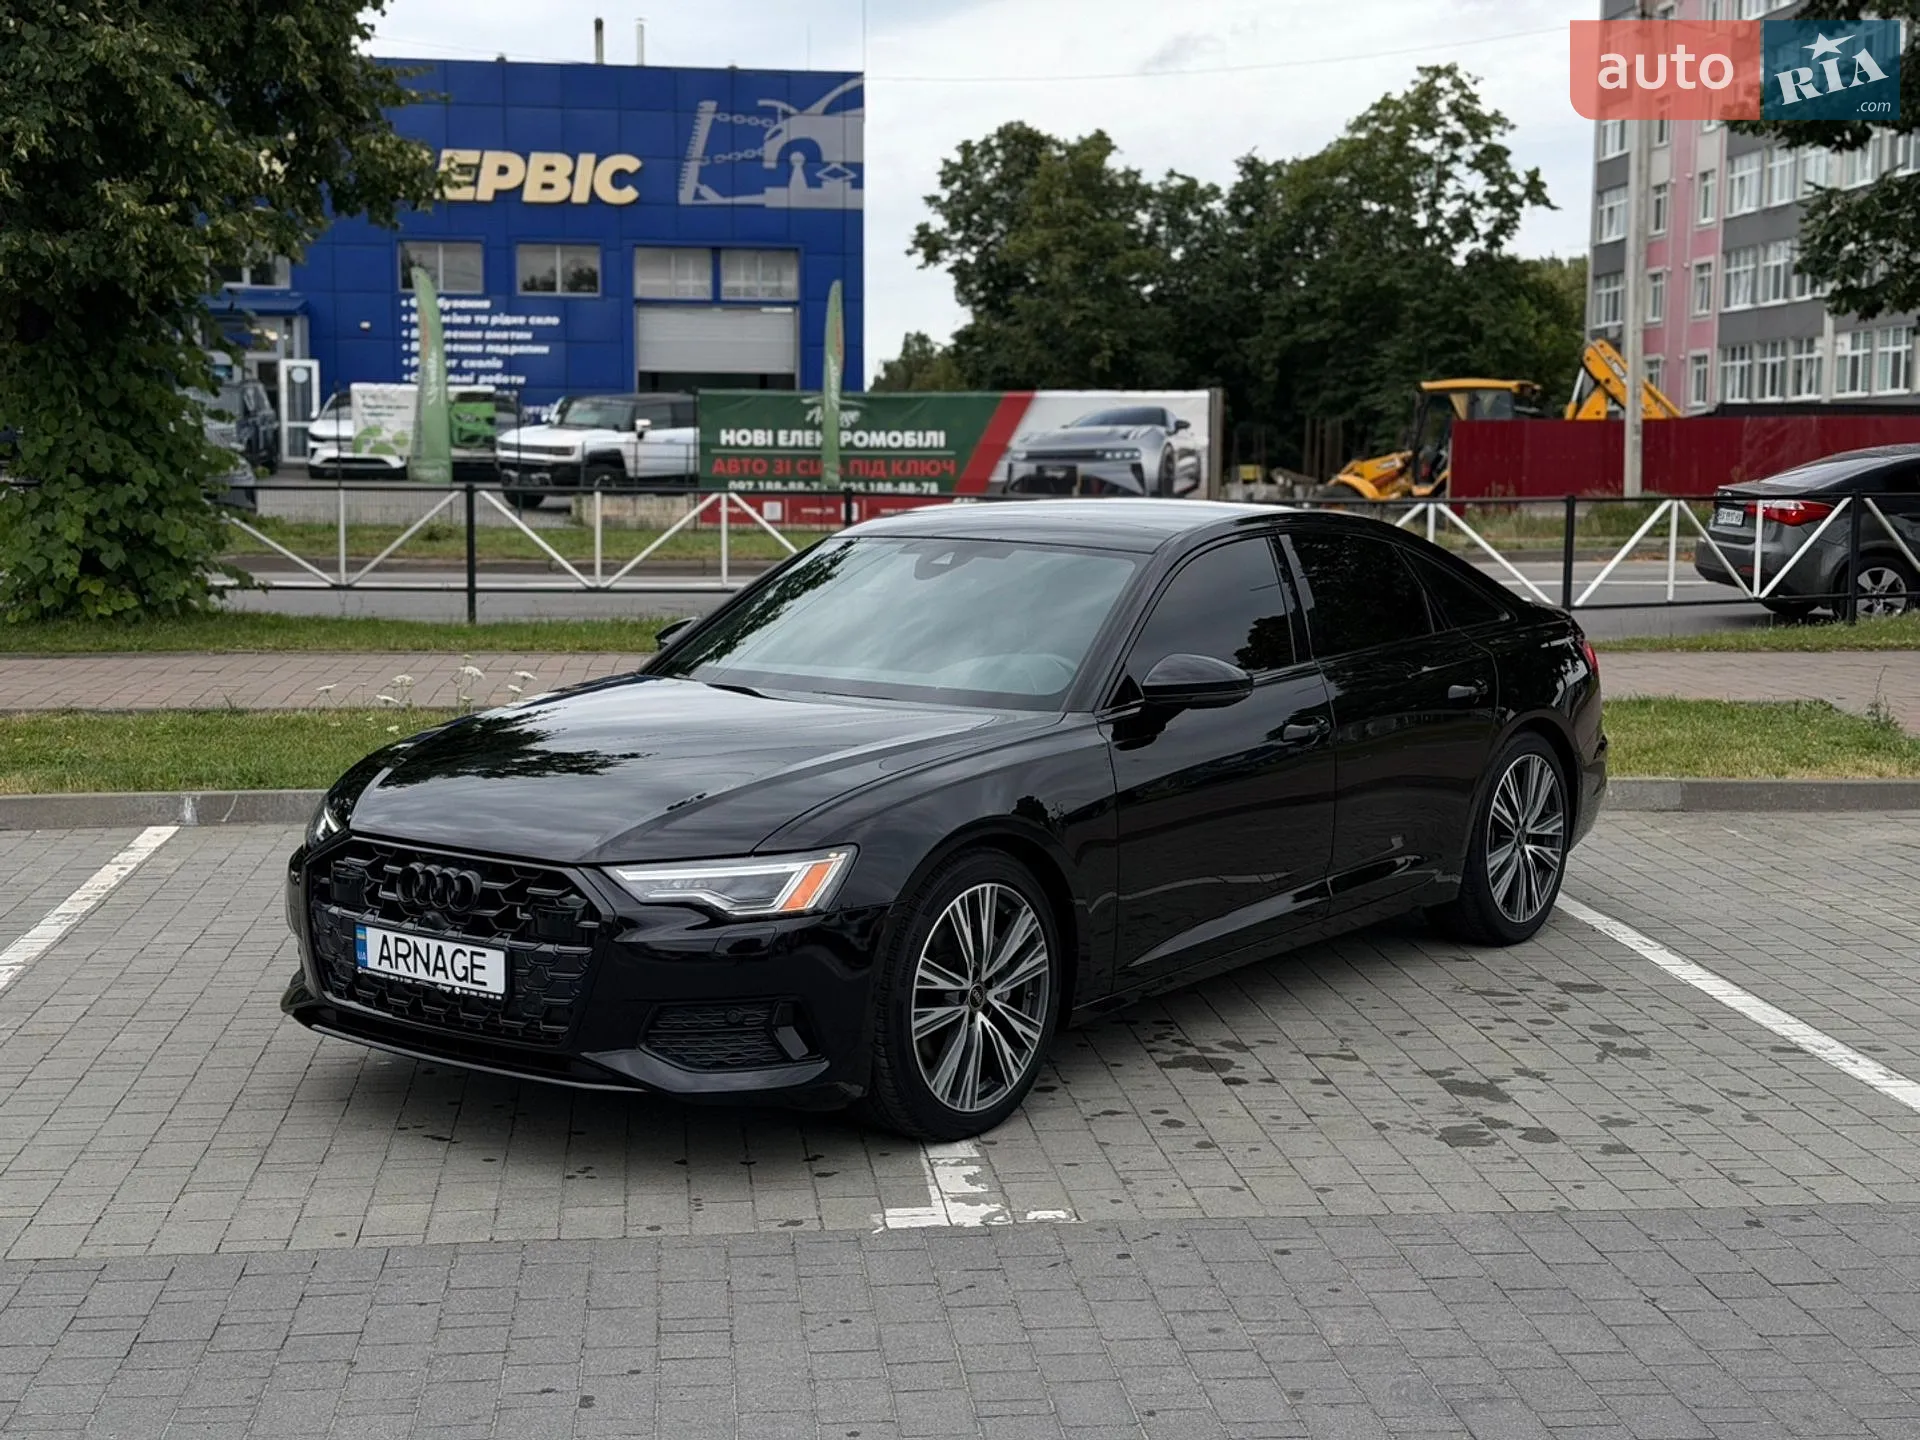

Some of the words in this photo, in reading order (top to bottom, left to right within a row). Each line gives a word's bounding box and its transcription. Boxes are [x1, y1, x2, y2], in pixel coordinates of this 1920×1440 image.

[433, 148, 643, 205] ЕРВІС
[720, 428, 774, 447] НОВІ
[712, 457, 768, 478] АВТО
[773, 458, 792, 477] ЗІ
[849, 459, 887, 479] ПІД
[891, 459, 956, 478] КЛЮЧ
[377, 934, 487, 987] ARNAGE
